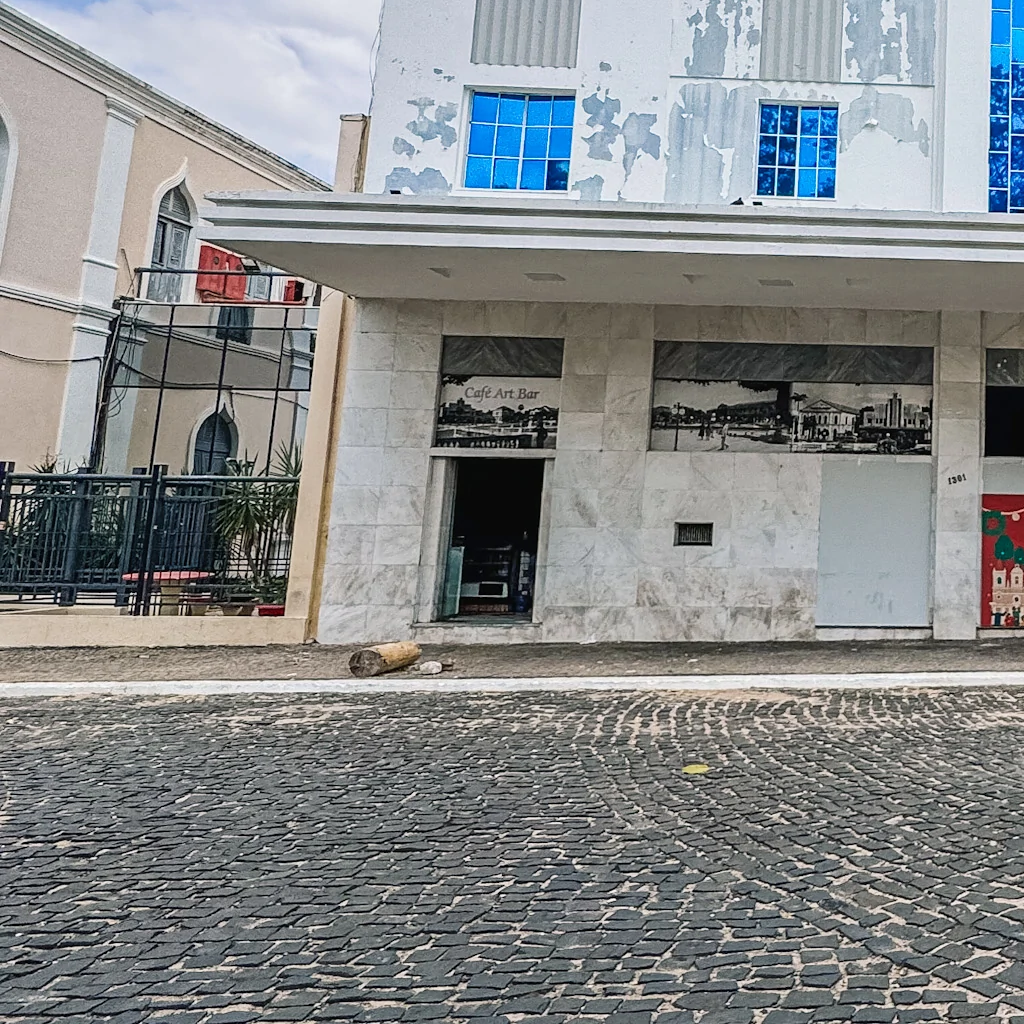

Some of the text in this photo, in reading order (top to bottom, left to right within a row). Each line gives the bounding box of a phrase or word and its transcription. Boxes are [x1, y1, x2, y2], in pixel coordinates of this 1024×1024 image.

[464, 385, 540, 403] Café Art Bar
[947, 473, 967, 485] 1301
